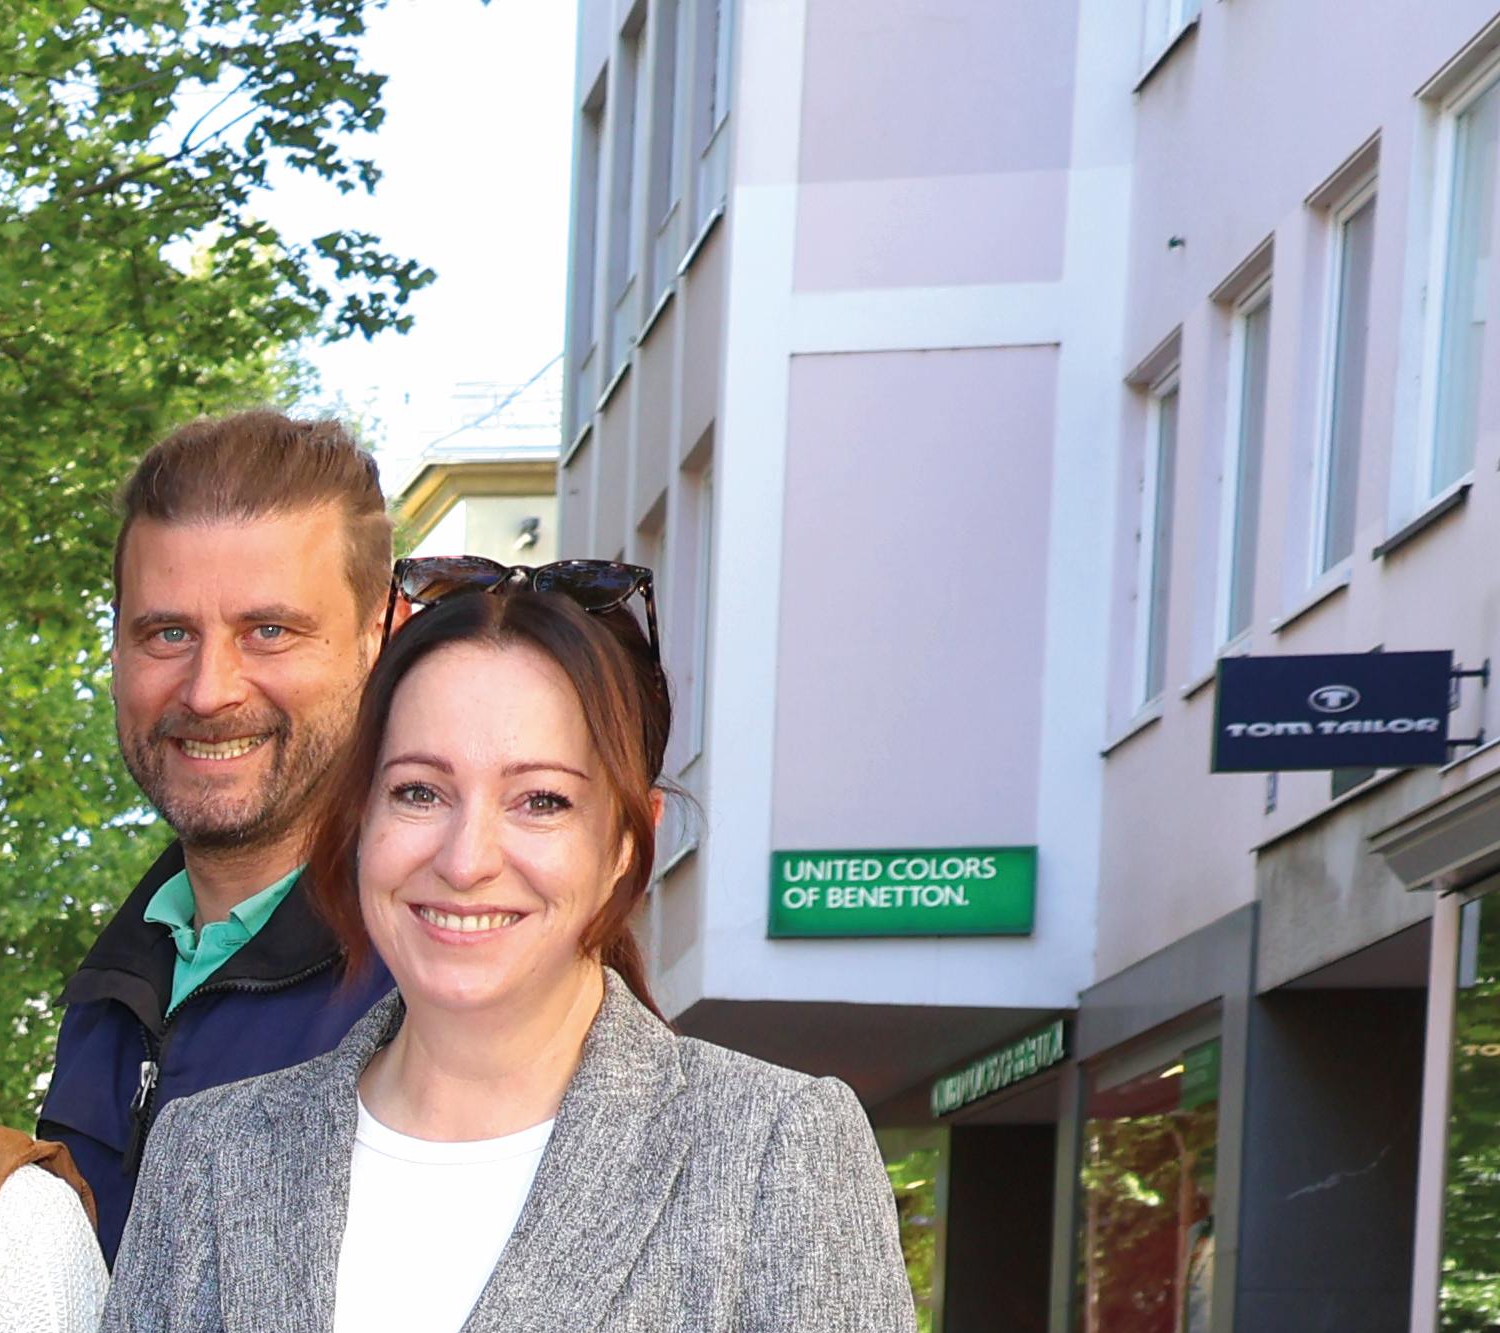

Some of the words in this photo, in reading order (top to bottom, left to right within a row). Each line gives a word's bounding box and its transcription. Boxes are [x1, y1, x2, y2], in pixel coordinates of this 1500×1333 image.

[1226, 722, 1313, 737] TOM
[1318, 718, 1440, 735] TAILOR
[783, 859, 882, 882] UNITED
[888, 856, 997, 880] COLORS
[782, 888, 820, 909] OF
[826, 885, 970, 909] BENETTON.
